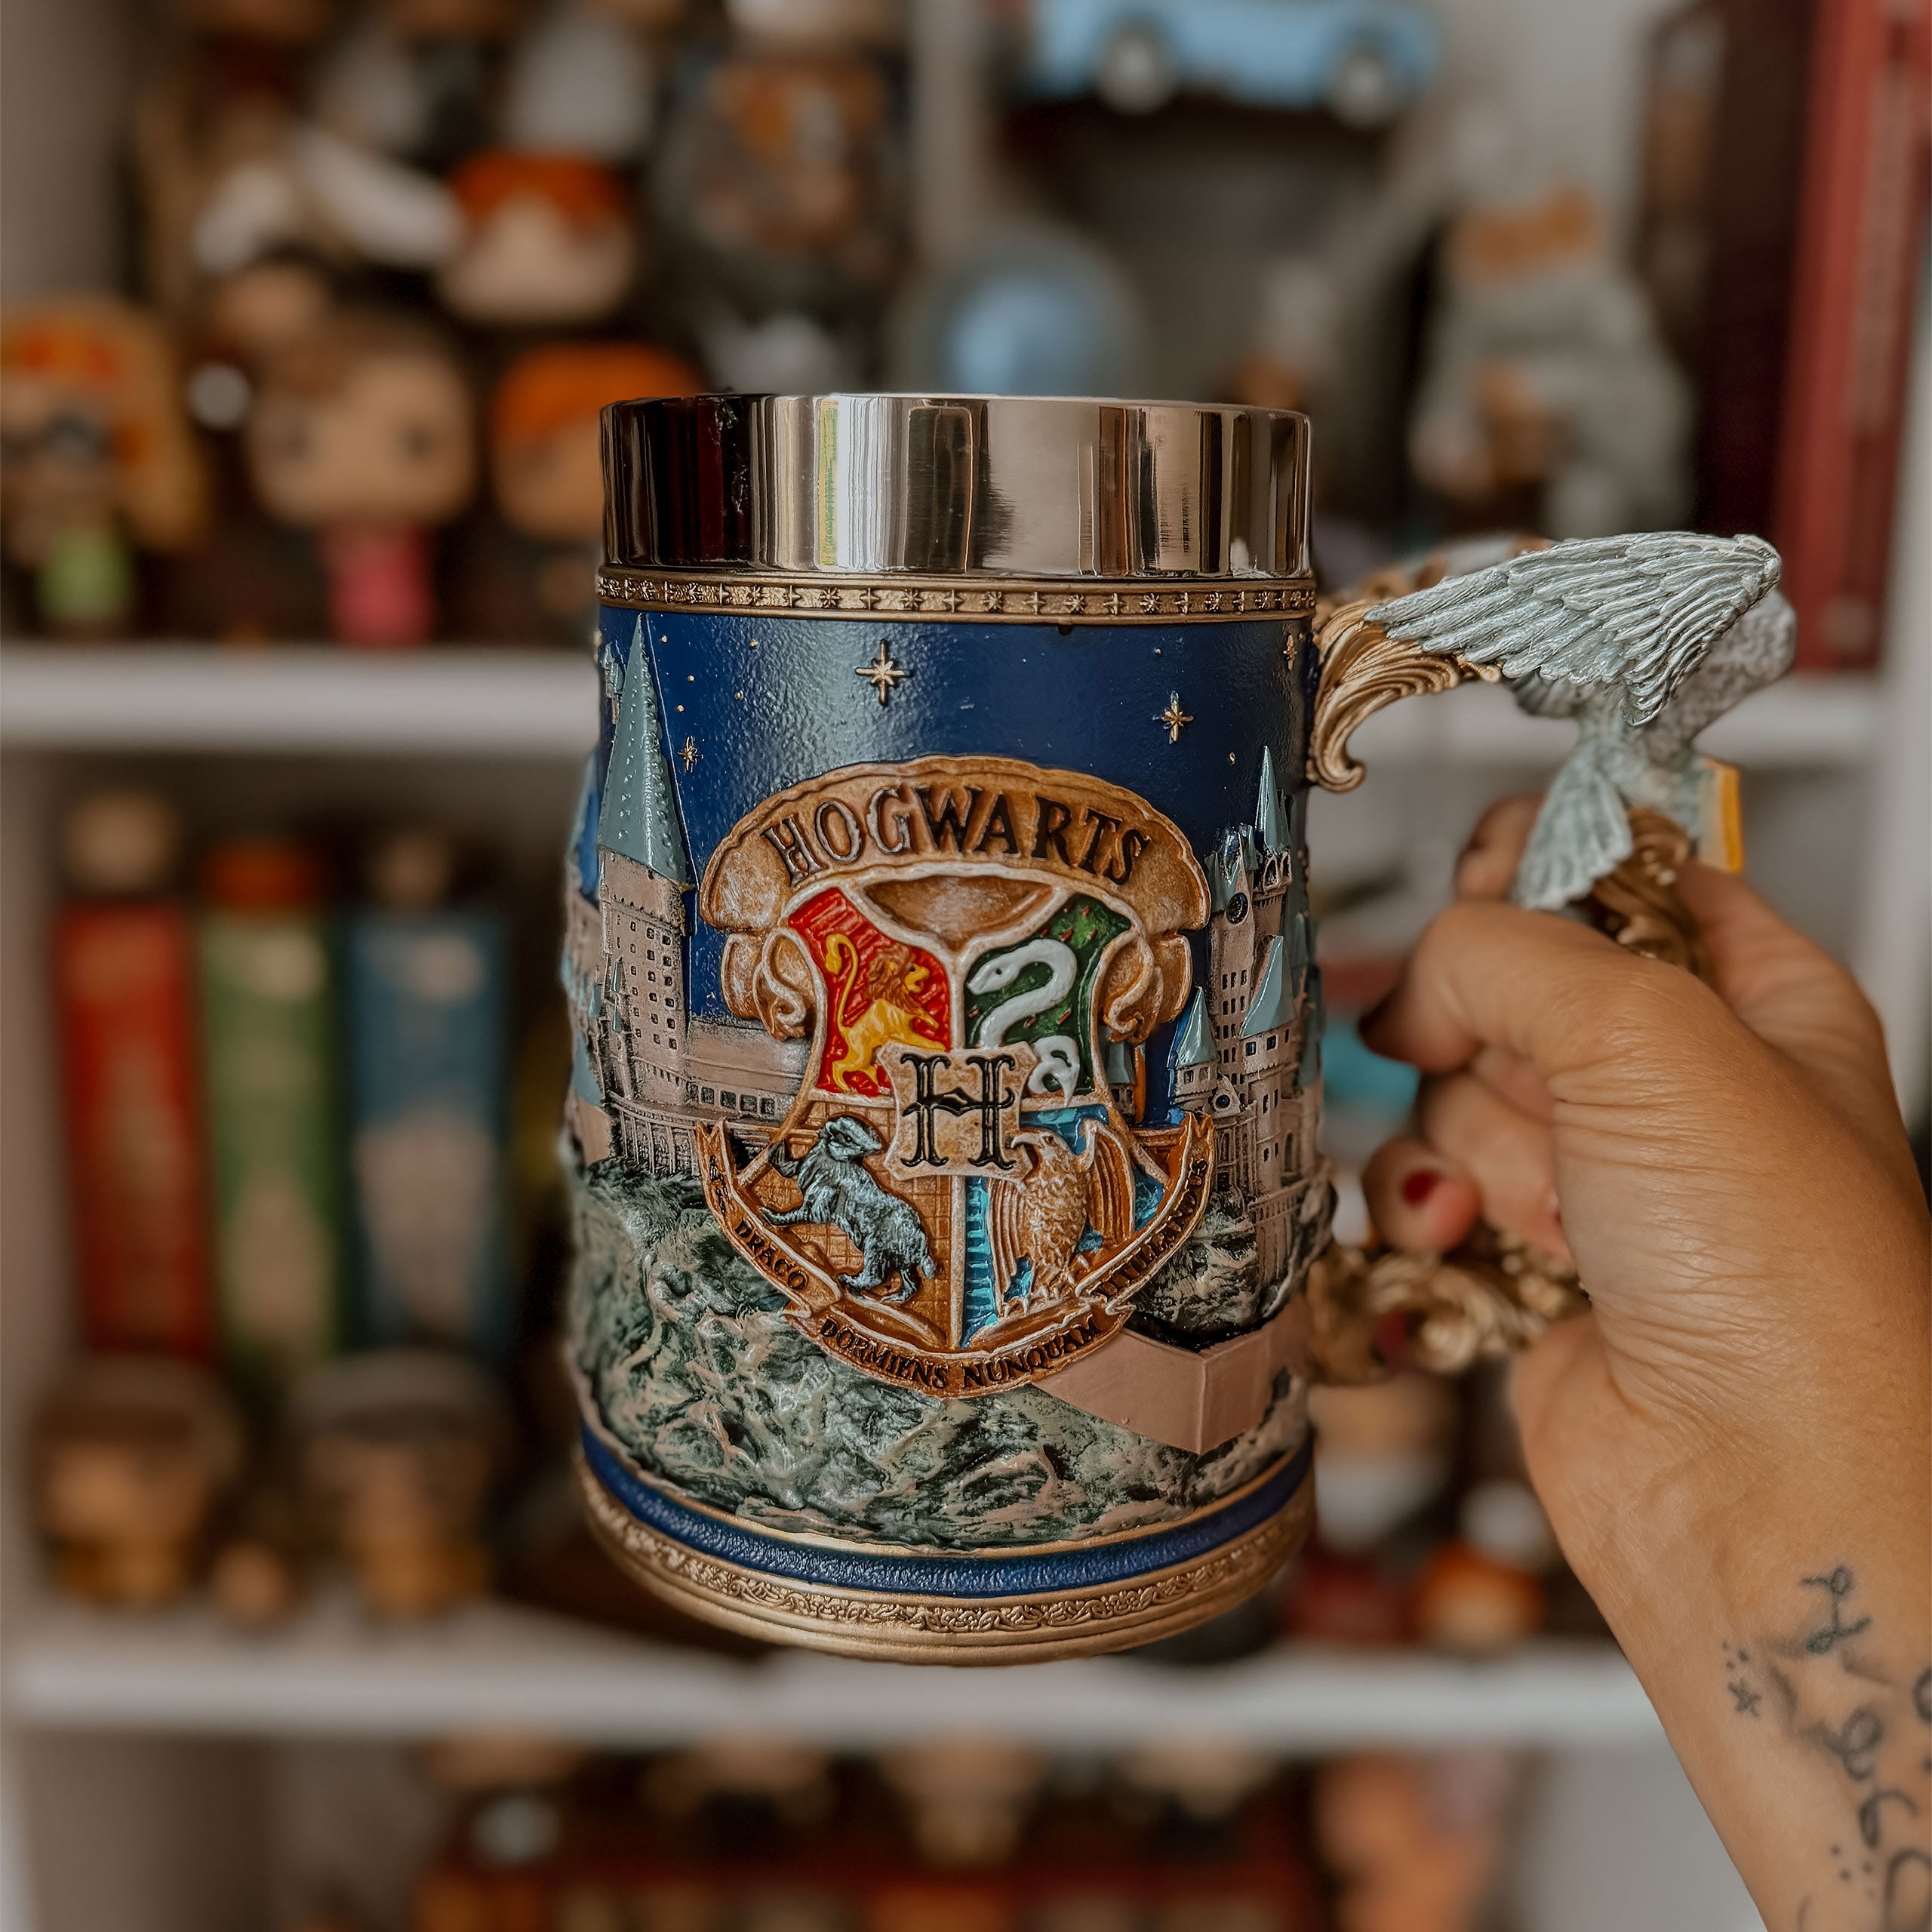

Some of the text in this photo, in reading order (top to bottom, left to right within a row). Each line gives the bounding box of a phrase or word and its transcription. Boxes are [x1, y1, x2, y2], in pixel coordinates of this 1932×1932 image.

[761, 783, 1152, 887] HOGWARTS
[900, 1053, 1017, 1171] H
[734, 1215, 808, 1291] DRACO
[820, 1317, 949, 1389] DORMIENS
[961, 1313, 1104, 1389] NUNQUAM
